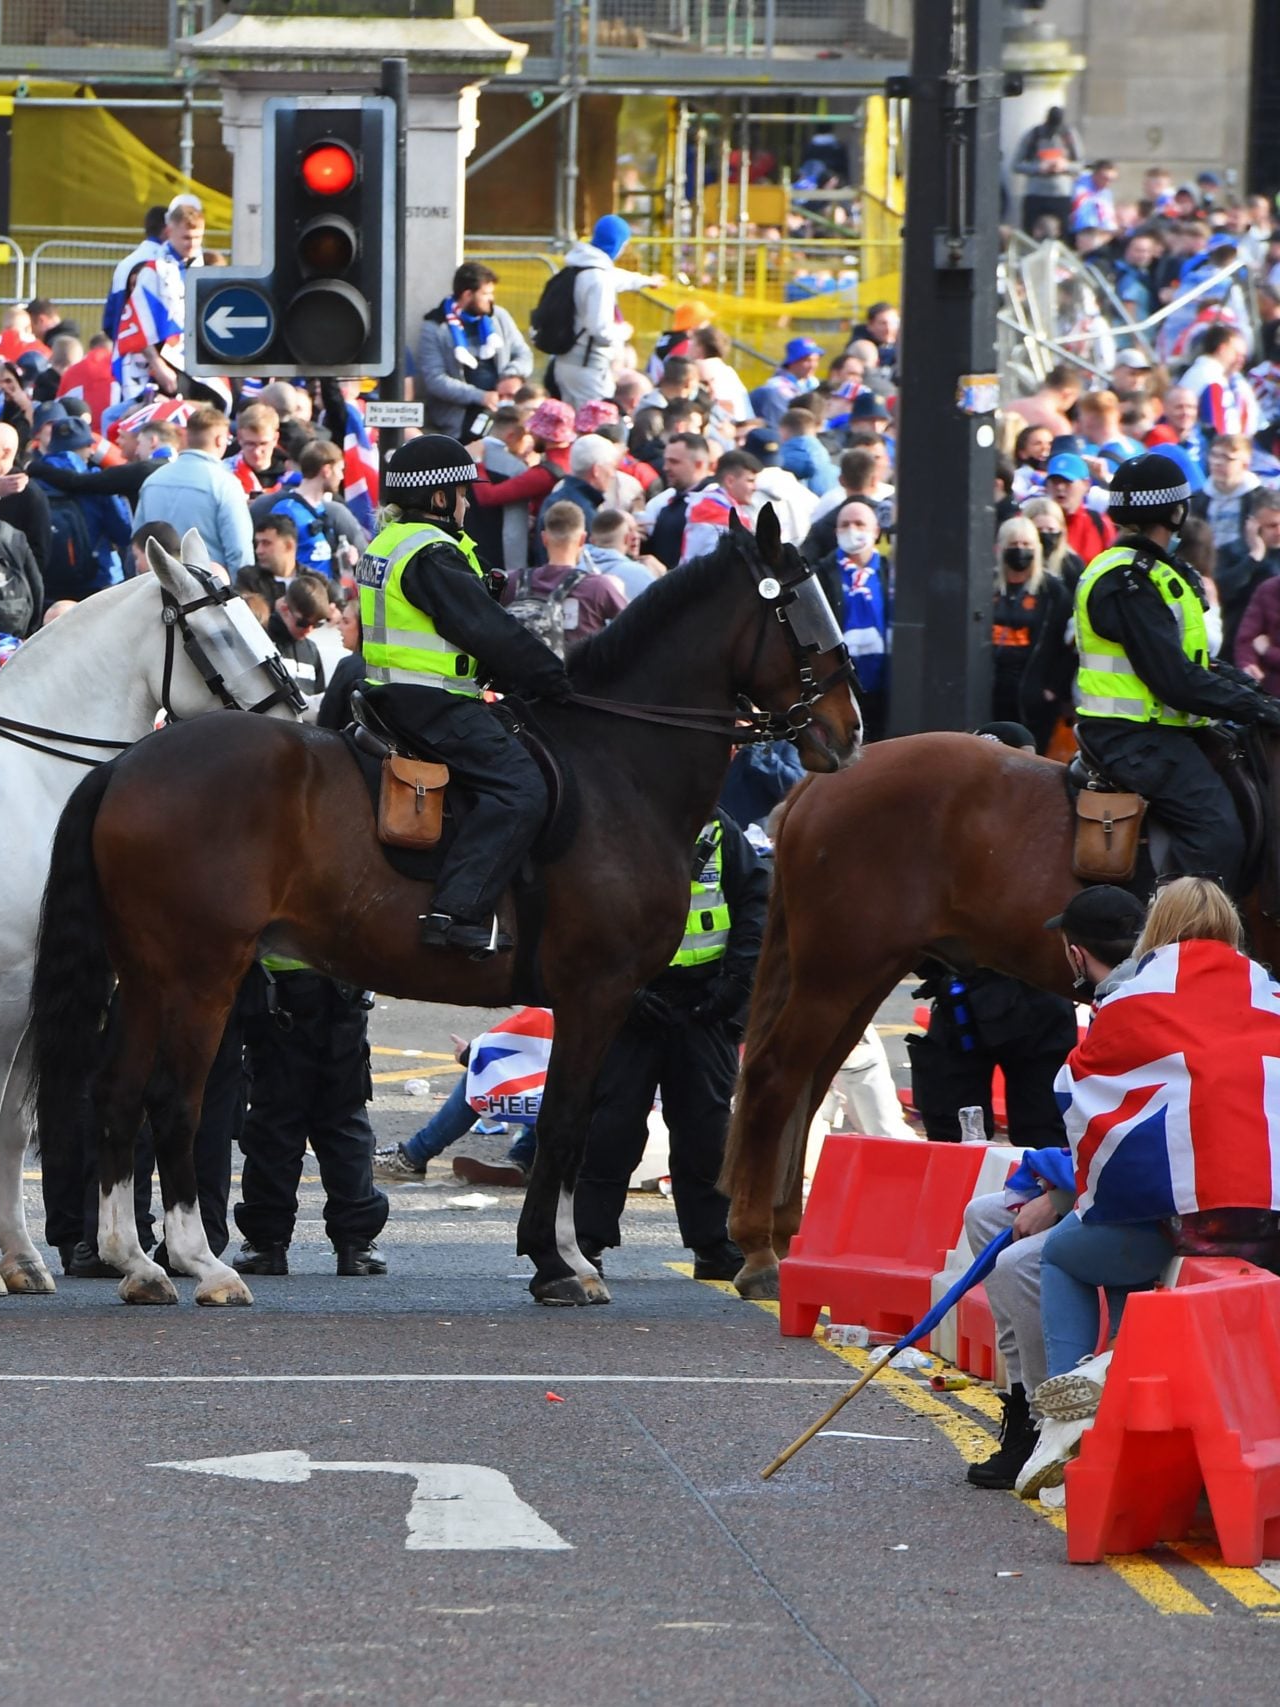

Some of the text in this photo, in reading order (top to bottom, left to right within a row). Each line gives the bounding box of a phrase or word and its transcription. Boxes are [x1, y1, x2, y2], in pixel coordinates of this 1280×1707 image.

[405, 206, 449, 219] STONE
[370, 406, 419, 416] No loading
[474, 1095, 540, 1115] CHEE
